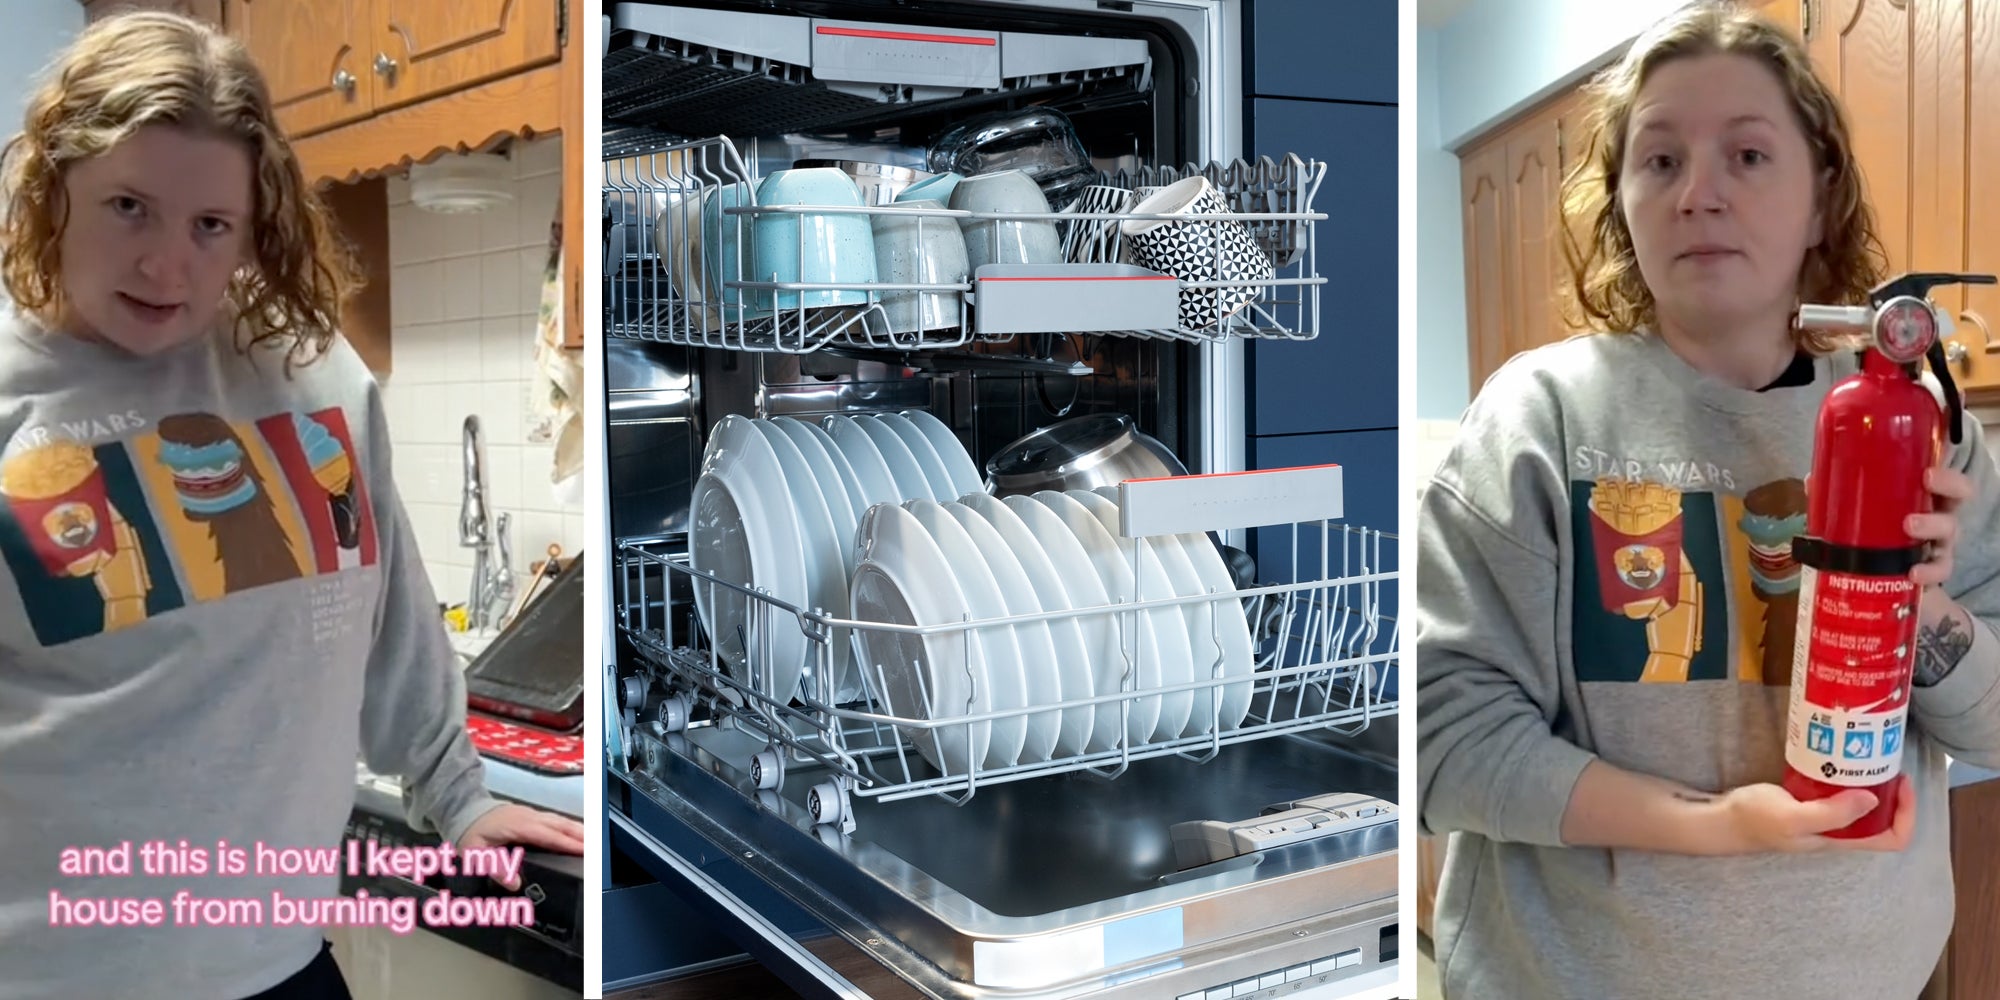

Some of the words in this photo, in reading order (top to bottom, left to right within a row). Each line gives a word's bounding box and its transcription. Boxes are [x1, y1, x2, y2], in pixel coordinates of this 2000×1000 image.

[60, 410, 147, 441] WARS
[1574, 445, 1643, 483] STAR
[1659, 460, 1736, 491] WARS
[1839, 768, 1864, 777] FIRST
[1865, 764, 1890, 777] ALERT
